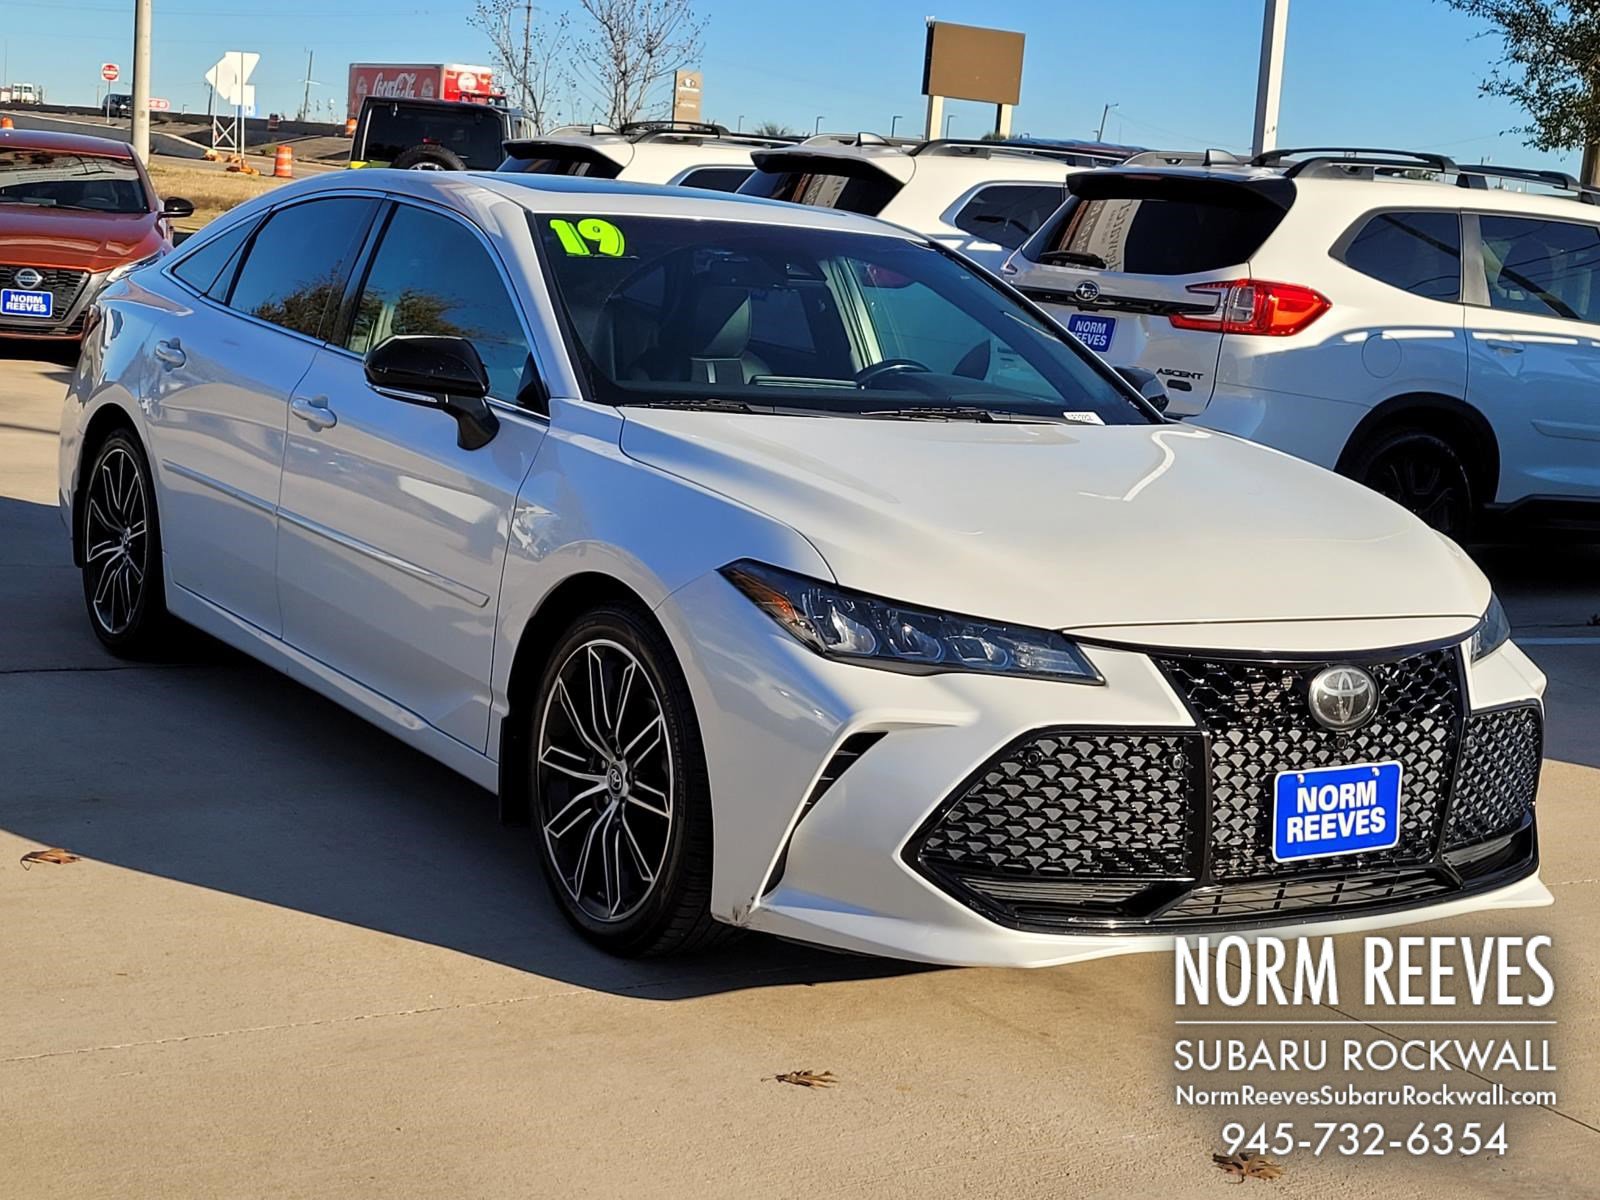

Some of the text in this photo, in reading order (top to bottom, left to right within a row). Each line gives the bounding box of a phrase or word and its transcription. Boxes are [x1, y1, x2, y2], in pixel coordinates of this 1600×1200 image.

[549, 218, 625, 257] 19
[11, 294, 43, 304] NORM
[6, 301, 47, 312] REEVES
[1075, 320, 1107, 334] NORM
[1156, 367, 1204, 380] ASCENT
[1297, 780, 1377, 814] NORM
[1286, 806, 1386, 844] REEVES
